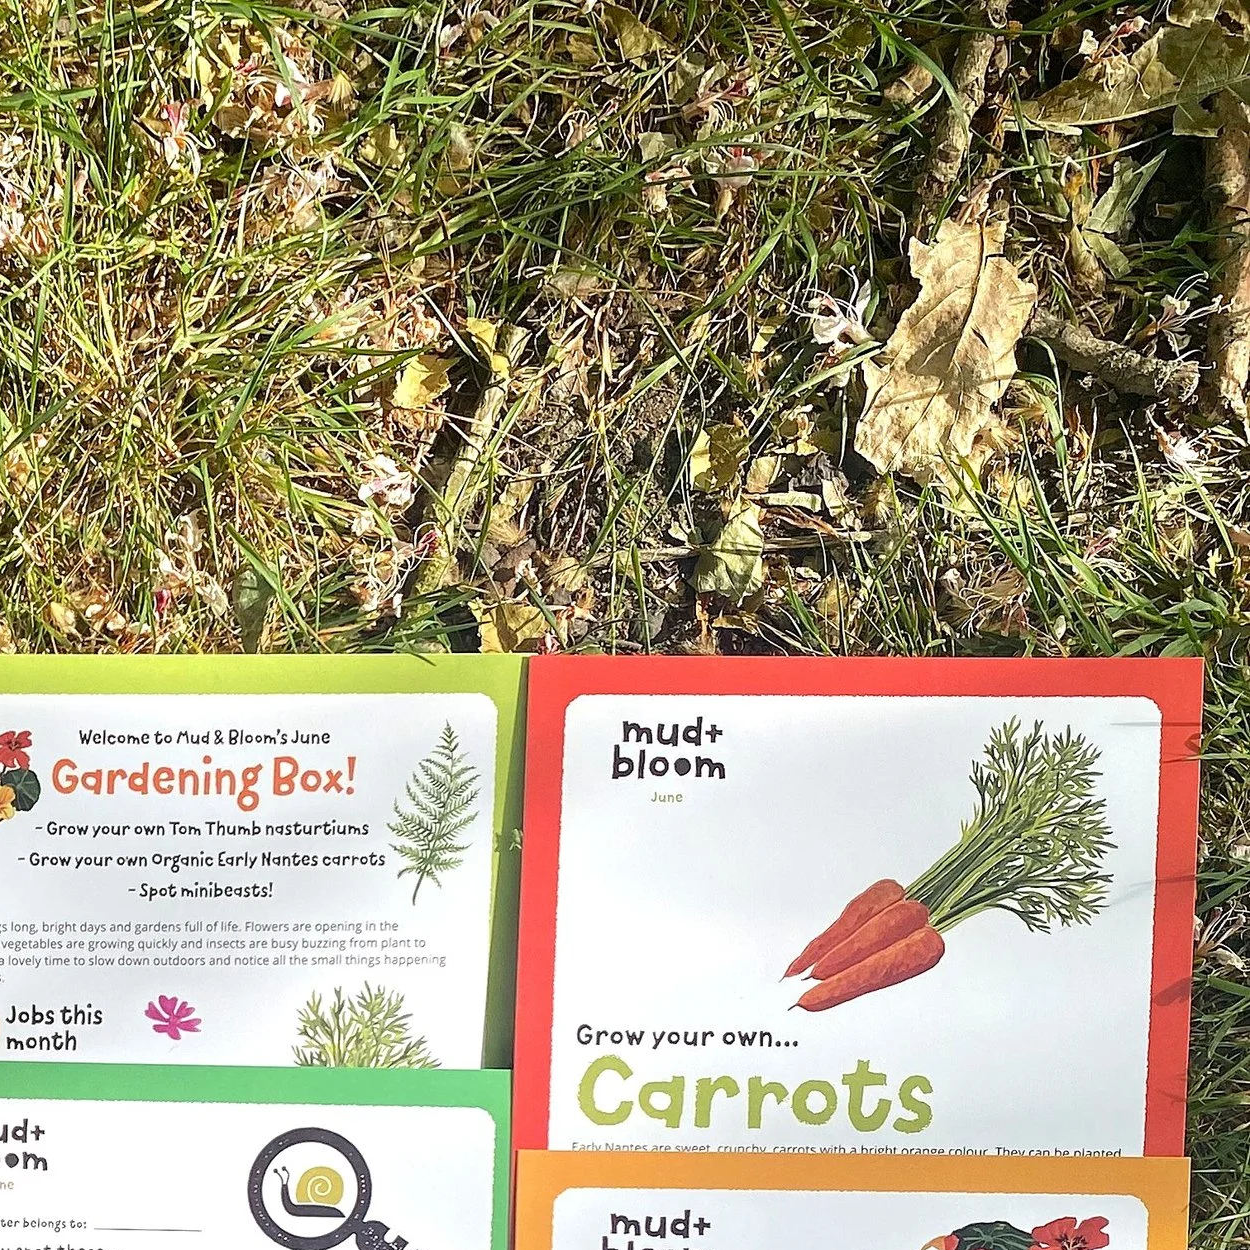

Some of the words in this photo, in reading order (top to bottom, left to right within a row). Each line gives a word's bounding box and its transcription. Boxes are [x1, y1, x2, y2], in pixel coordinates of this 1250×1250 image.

[79, 729, 150, 745] Welcome
[154, 731, 172, 745] to
[176, 730, 210, 745] Mud
[214, 729, 224, 745] &
[291, 730, 330, 744] June
[622, 716, 723, 747] mud+
[611, 744, 726, 779] bloom
[52, 755, 263, 812] Gardening
[273, 756, 356, 796] Box!
[651, 791, 683, 803] June
[47, 821, 89, 836] Grow
[92, 825, 131, 838] your
[134, 825, 165, 836] own
[169, 821, 201, 836] Tom
[205, 820, 261, 836] Thumb
[266, 819, 369, 836] nasturtiums
[29, 852, 71, 867] Grow
[75, 856, 113, 869] your
[116, 856, 147, 867] own
[152, 851, 214, 873] Organic
[218, 851, 258, 869] Early
[262, 851, 318, 867] Nantes
[322, 852, 385, 866] carrots
[139, 883, 177, 902] Spot
[181, 881, 273, 898] minibeasts!
[11, 921, 38, 935] long,
[42, 921, 77, 935] bright
[80, 922, 107, 935] days
[109, 921, 131, 932] and
[134, 921, 181, 935] gardens
[184, 921, 203, 932] full
[206, 921, 219, 932] of
[221, 921, 241, 932] life.
[245, 921, 289, 932] Flowers
[292, 923, 312, 932] are
[315, 923, 362, 934] opening
[366, 923, 376, 931] in
[380, 921, 399, 931] the
[5, 1004, 54, 1025] Jobs
[60, 1003, 102, 1025] this
[6, 1030, 77, 1051] month
[577, 1024, 645, 1046] Grow
[652, 1031, 715, 1050] your
[722, 1030, 798, 1047] own...
[577, 1054, 934, 1134] Carrots
[23, 1217, 66, 1233] belongs
[69, 1219, 87, 1229] to:
[610, 1209, 711, 1239] mud+
